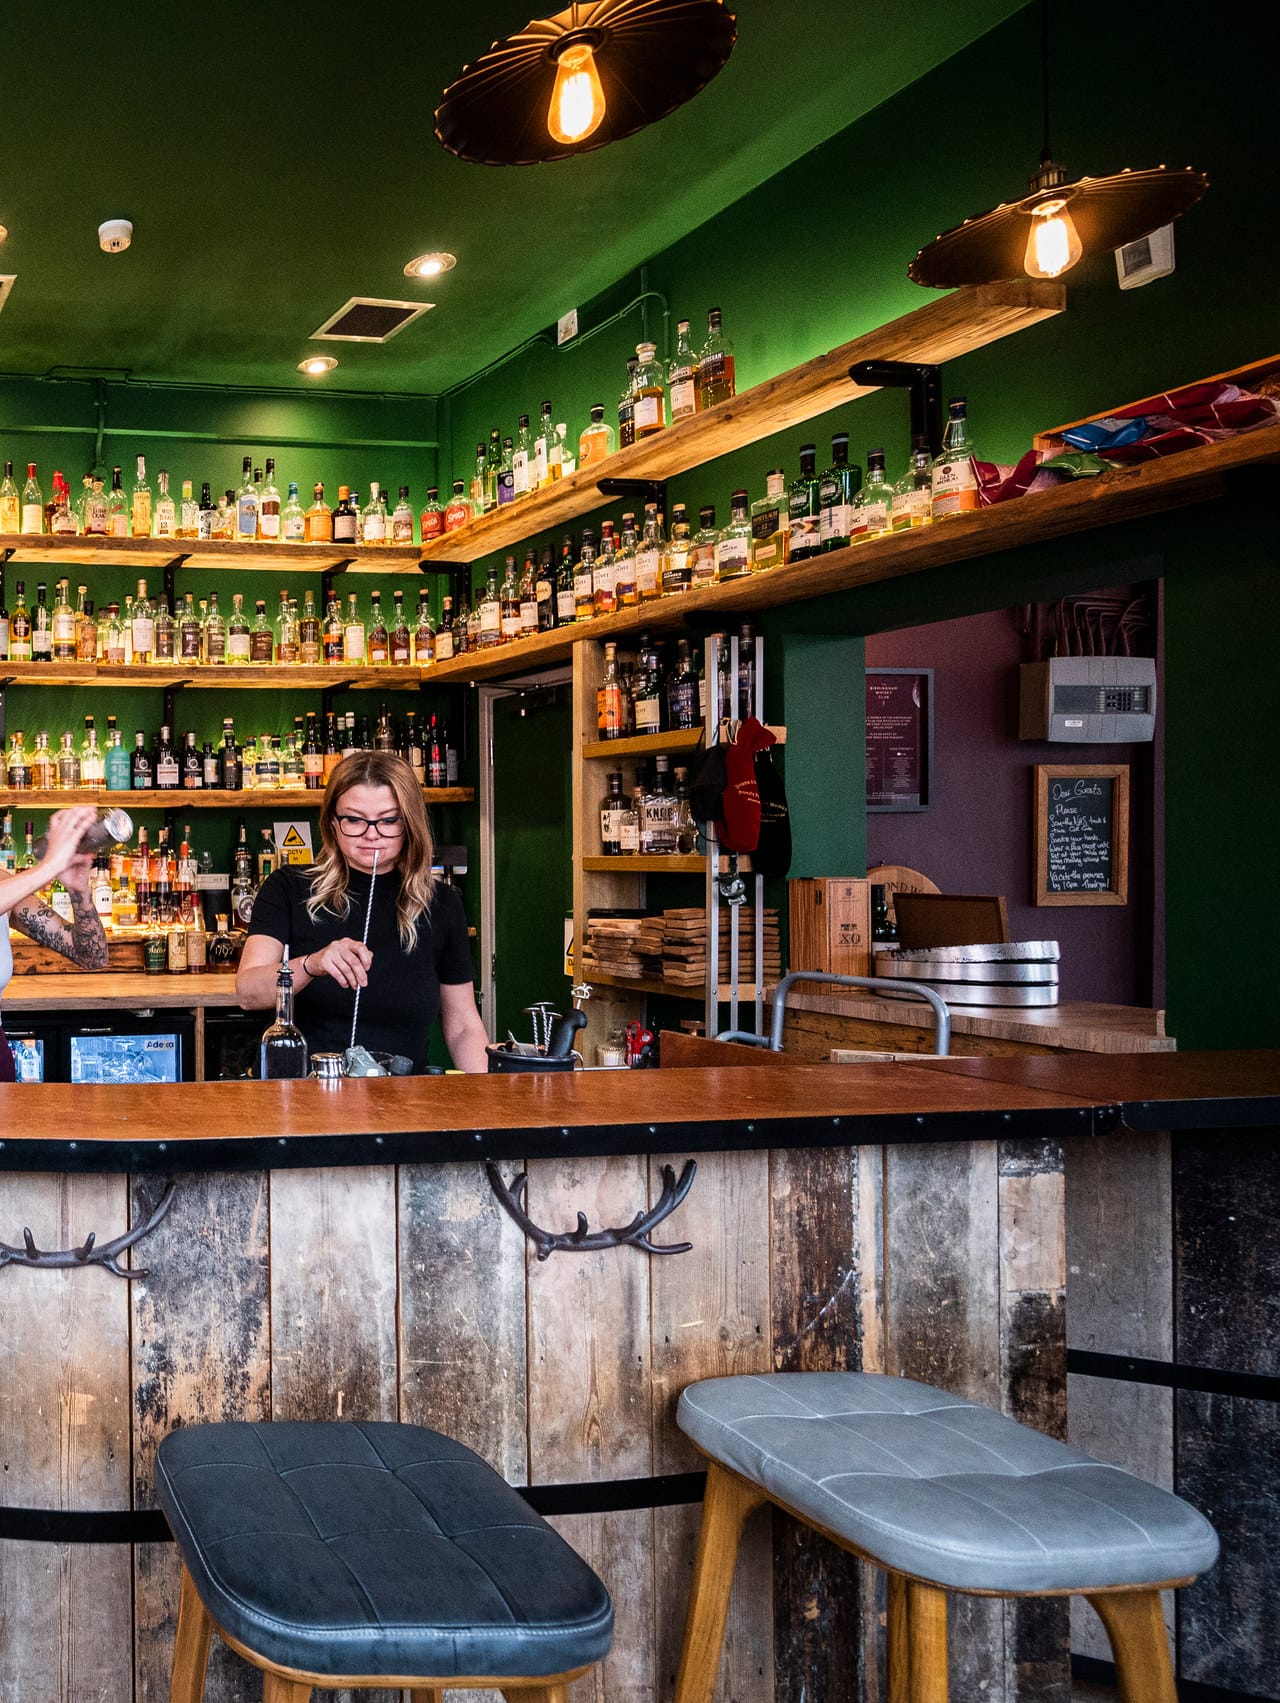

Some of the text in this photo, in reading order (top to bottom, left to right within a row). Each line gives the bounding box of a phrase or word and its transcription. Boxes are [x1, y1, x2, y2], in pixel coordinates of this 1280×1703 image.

[646, 807, 673, 818] KNOB
[838, 933, 861, 945] XO
[215, 944, 233, 957] 1792
[147, 1040, 174, 1049] Adexa
